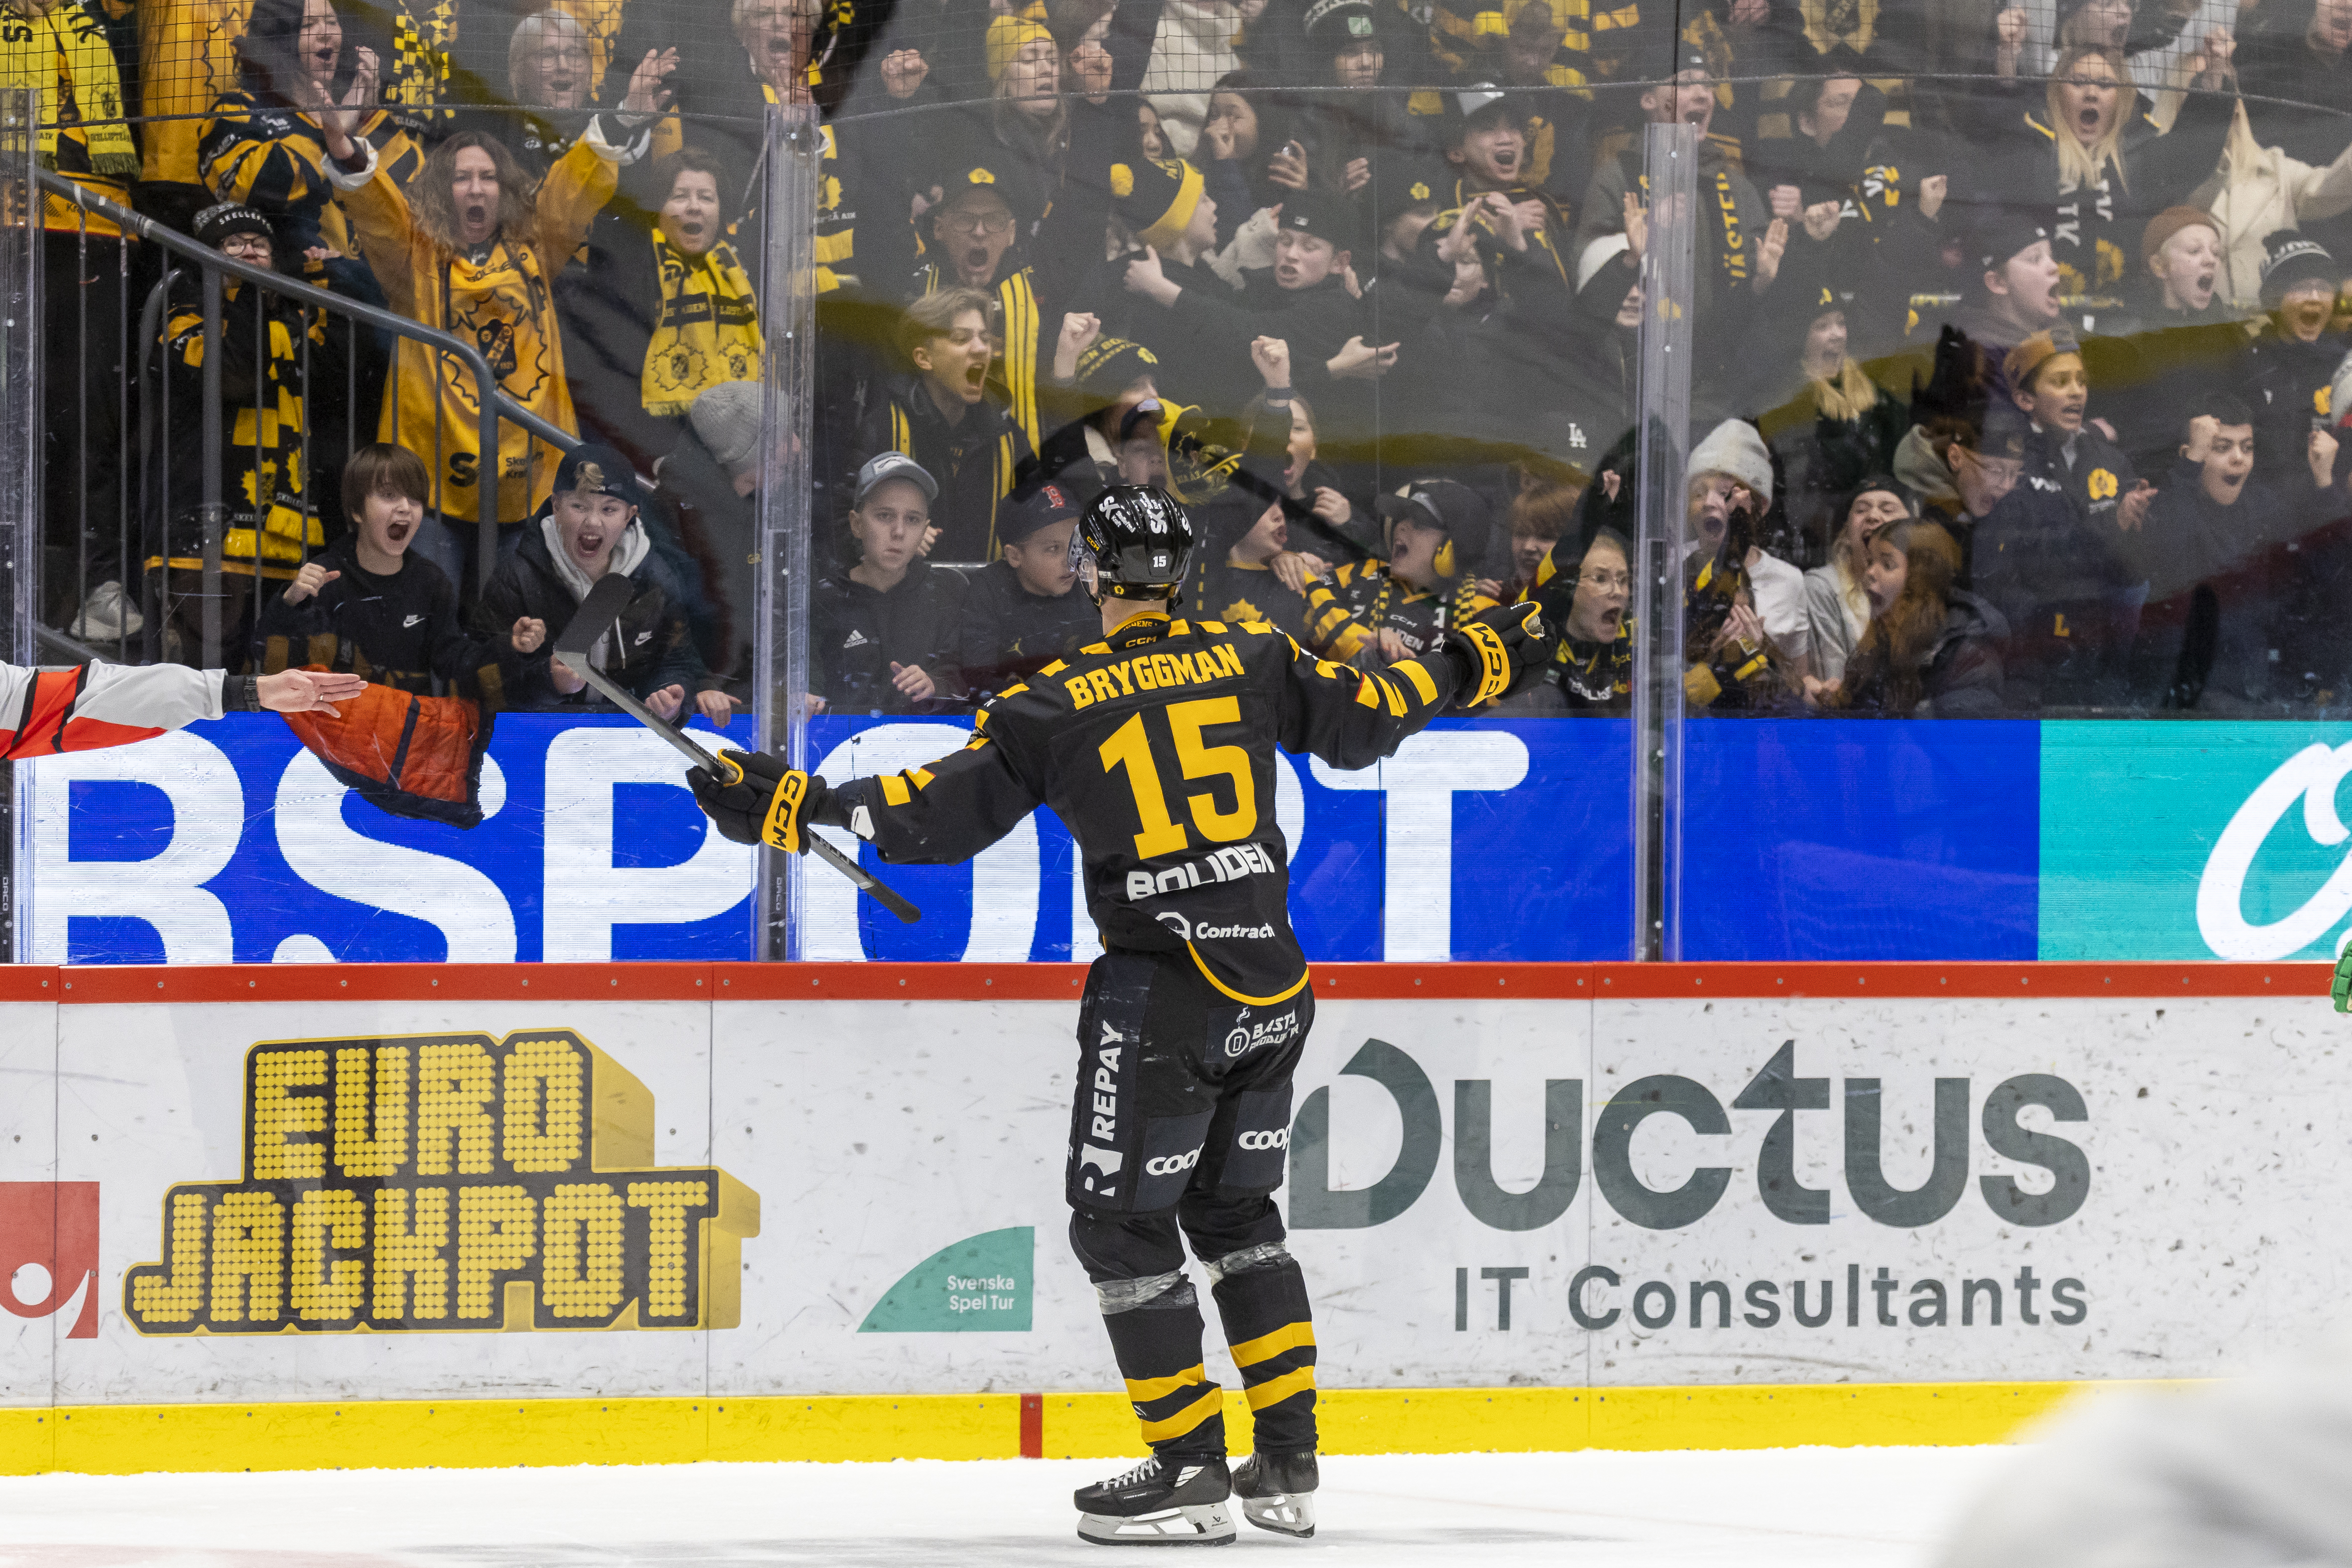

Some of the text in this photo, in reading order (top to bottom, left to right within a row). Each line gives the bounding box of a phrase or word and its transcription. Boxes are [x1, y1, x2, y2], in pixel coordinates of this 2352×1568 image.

[1042, 485, 1065, 508] B
[1111, 515, 1122, 528] Kraft
[1087, 536, 1099, 551] CCM
[1153, 556, 1167, 568] 15
[1125, 636, 1157, 648] CCM
[1064, 643, 1245, 710] BRYGGMAN
[1471, 625, 1503, 697] CCM
[1098, 696, 1257, 859] 15
[773, 774, 802, 849] CCM
[1196, 922, 1275, 939] Contract
[1091, 1019, 1123, 1142] REPAY
[253, 1038, 584, 1181] EURO
[1146, 1141, 1205, 1176] coo
[132, 1181, 710, 1323] JACKPOT
[947, 1274, 1015, 1291] Svenska
[1455, 1263, 2087, 1332] IT Consultants
[949, 1294, 1015, 1313] Spel Tur
